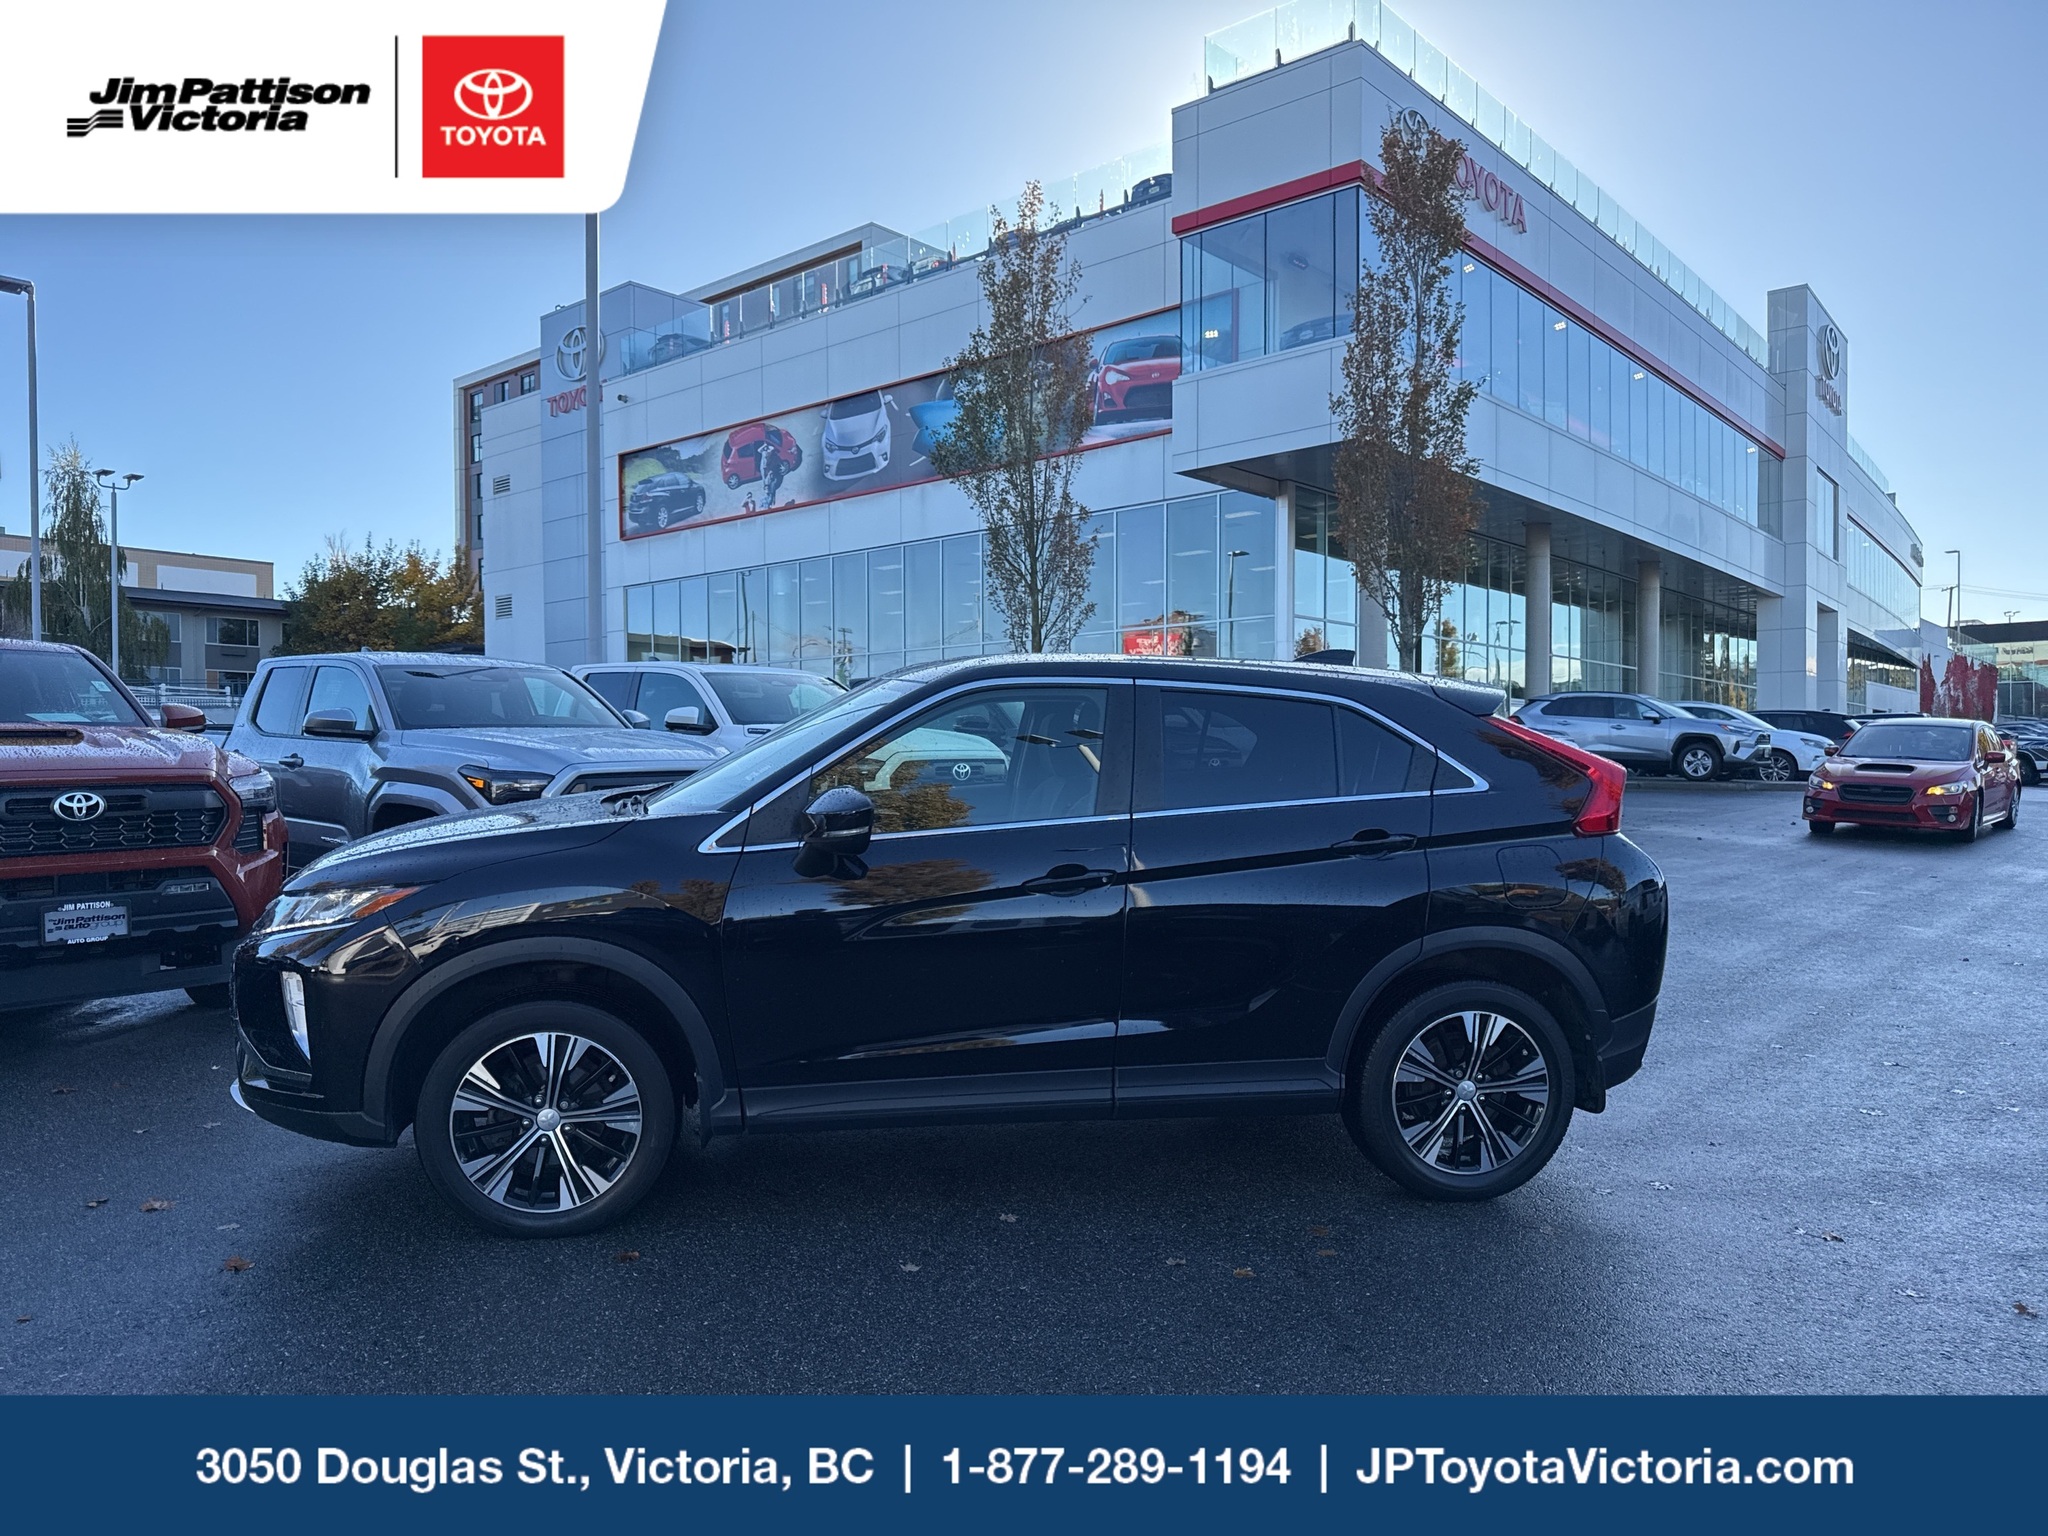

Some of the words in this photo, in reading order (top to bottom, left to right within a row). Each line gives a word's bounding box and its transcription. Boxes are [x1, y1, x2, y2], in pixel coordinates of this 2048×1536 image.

[1446, 143, 1527, 234] OYOTA
[61, 903, 75, 911] JIM
[76, 901, 111, 910] PATTISON
[67, 937, 85, 945] AUTO
[86, 935, 109, 943] GROUP
